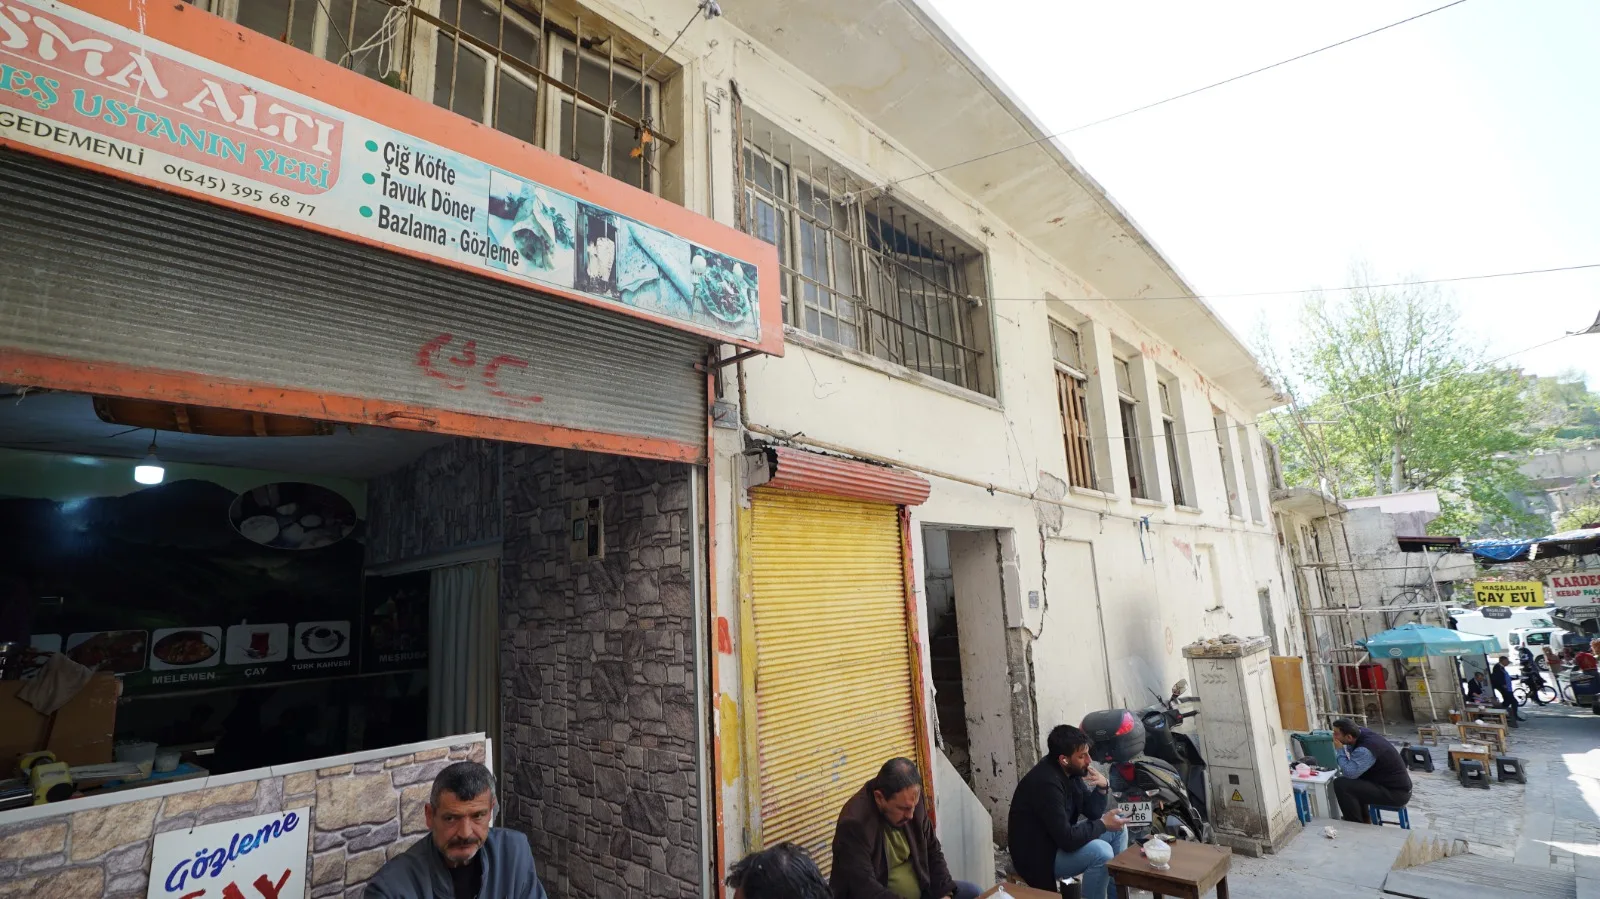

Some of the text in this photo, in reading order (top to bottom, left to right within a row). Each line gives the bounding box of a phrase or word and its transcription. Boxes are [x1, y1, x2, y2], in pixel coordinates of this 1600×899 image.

[72, 88, 246, 165] USTANIN
[254, 148, 330, 190] YERİ
[183, 79, 334, 156] ALTI
[0, 111, 144, 166] GEDEMENLİ
[232, 182, 262, 202] 395
[269, 192, 290, 208] 68
[296, 201, 316, 217] 77
[383, 141, 456, 185] Çiğ Köfte
[381, 172, 476, 222] Tavuk Döner
[378, 204, 447, 246] Bazlama
[460, 229, 520, 266] Gözleme
[1477, 588, 1537, 605] ÇAY EVİ
[1556, 588, 1600, 597] KEBAP PAÇ
[152, 671, 216, 685] MELEMEN
[244, 666, 269, 678] ÇAY
[165, 812, 300, 893] Gözleme
